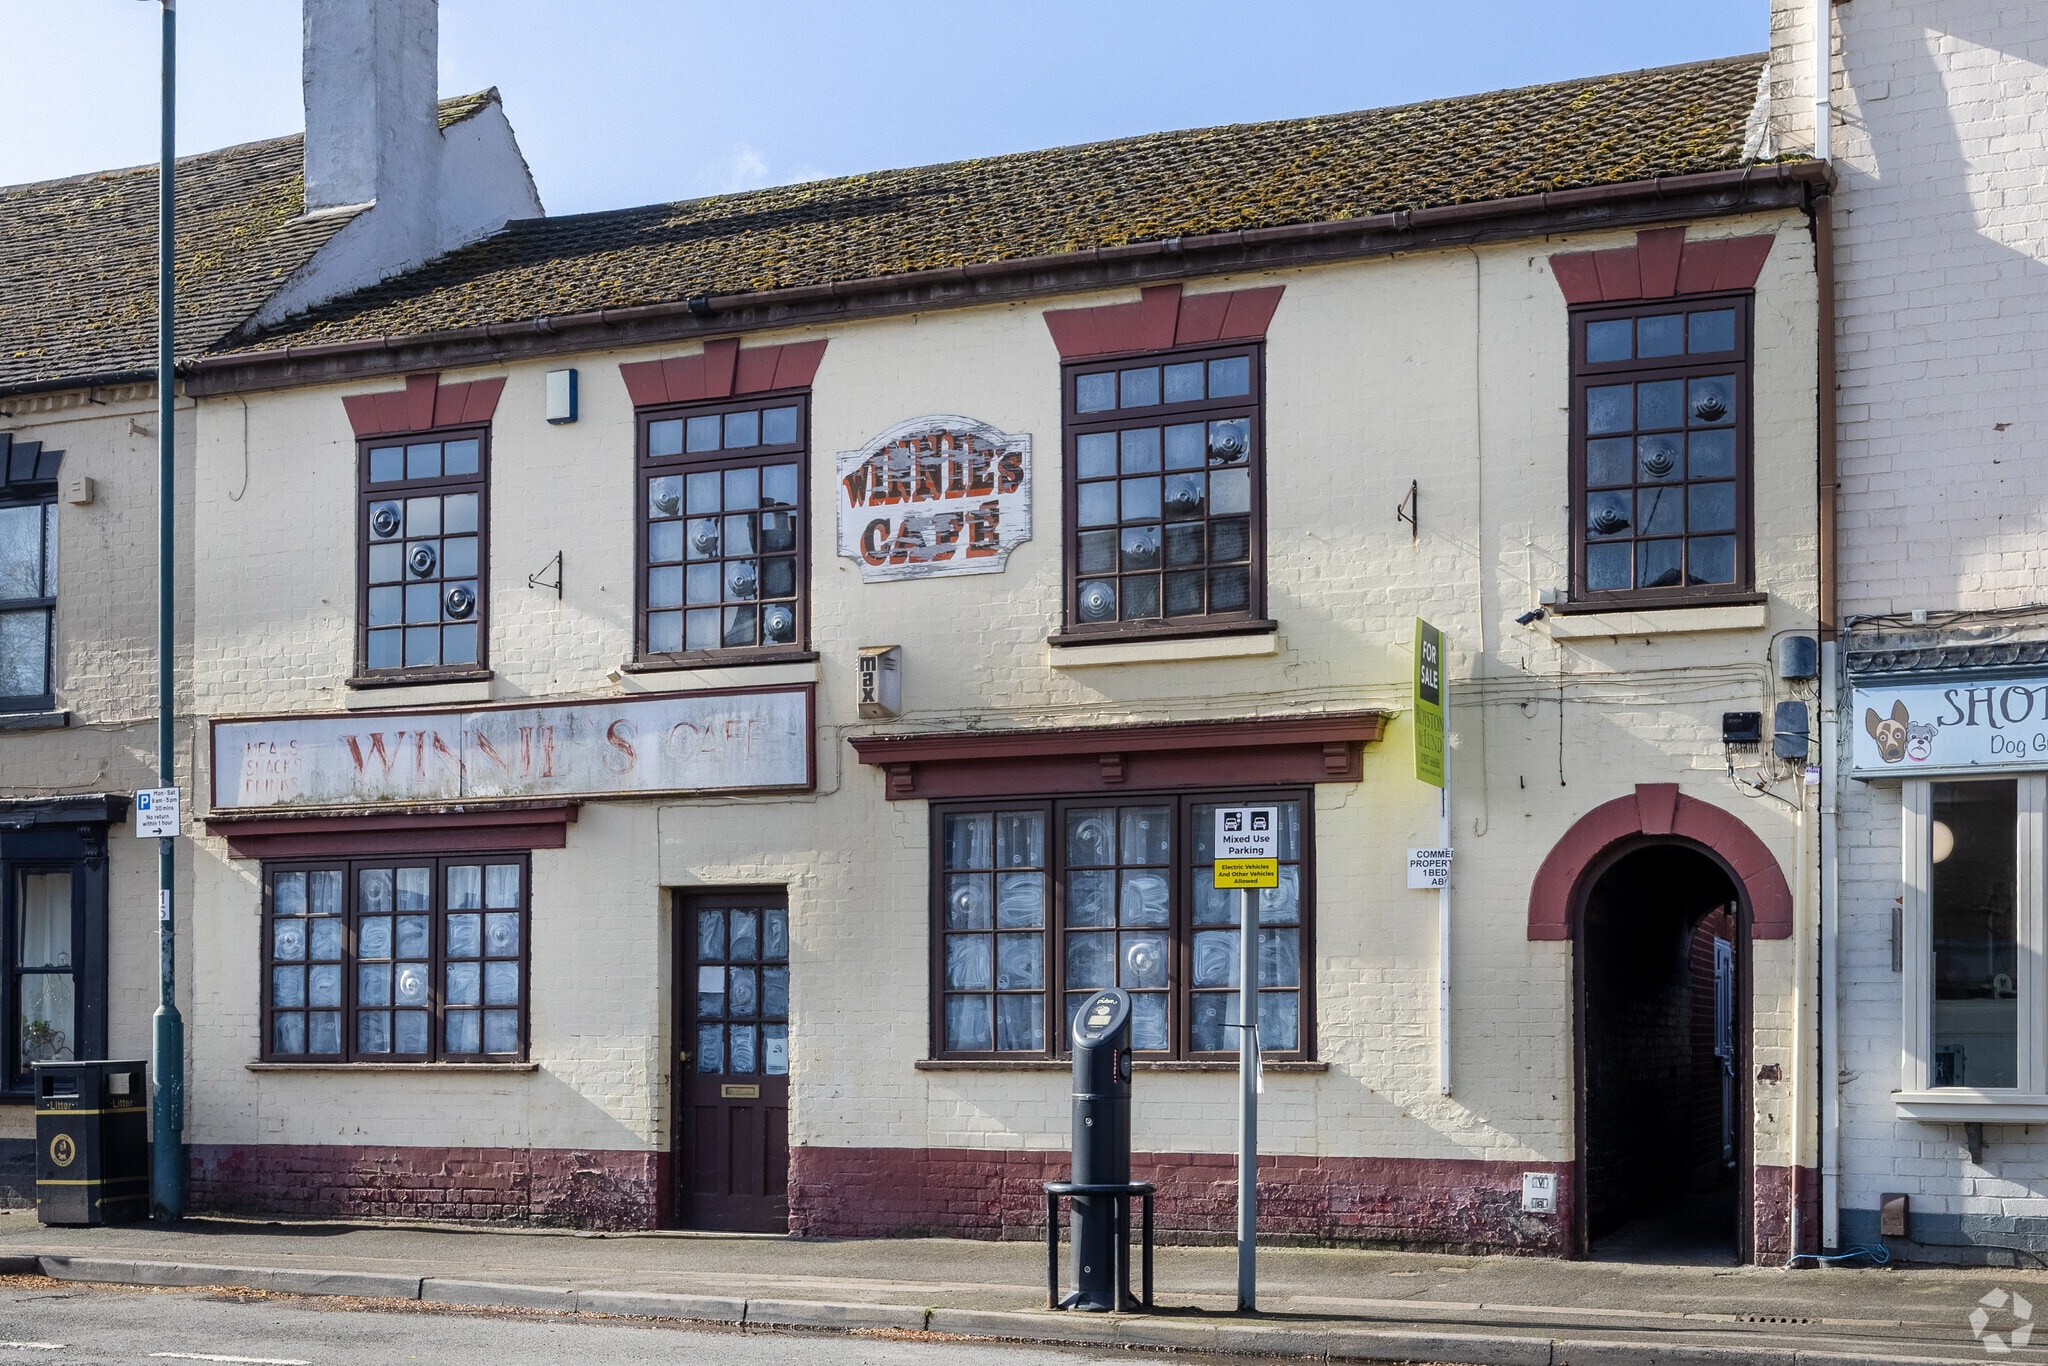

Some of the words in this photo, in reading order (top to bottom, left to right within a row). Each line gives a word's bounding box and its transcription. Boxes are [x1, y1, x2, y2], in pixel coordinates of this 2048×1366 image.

[1422, 640, 1437, 665] FOR
[860, 656, 876, 703] max
[1421, 664, 1438, 689] SALE
[246, 739, 298, 756] MEAS
[1991, 735, 2026, 758] Dog
[2033, 733, 2048, 751] G
[246, 757, 301, 776] SACKS
[1223, 834, 1250, 843] Mixed
[1253, 835, 1270, 843] Use
[1229, 846, 1264, 855] Parking
[112, 1100, 133, 1108] Litter
